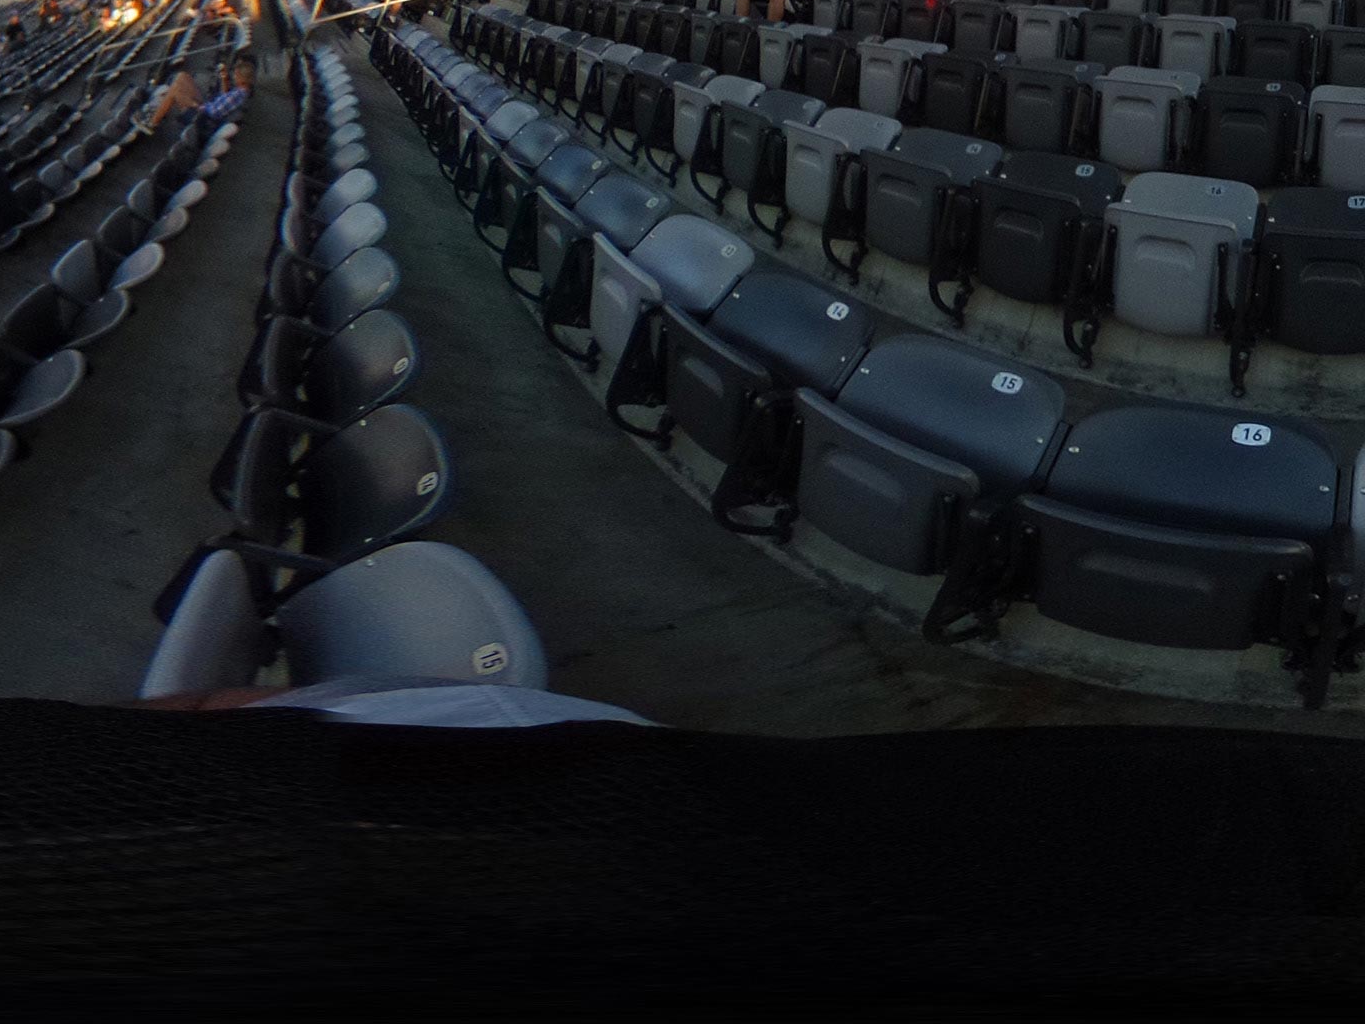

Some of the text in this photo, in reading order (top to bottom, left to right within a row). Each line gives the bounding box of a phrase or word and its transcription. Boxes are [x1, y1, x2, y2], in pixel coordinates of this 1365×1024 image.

[999, 377, 1017, 391] 15
[1243, 427, 1264, 442] 16
[479, 649, 498, 670] 15
